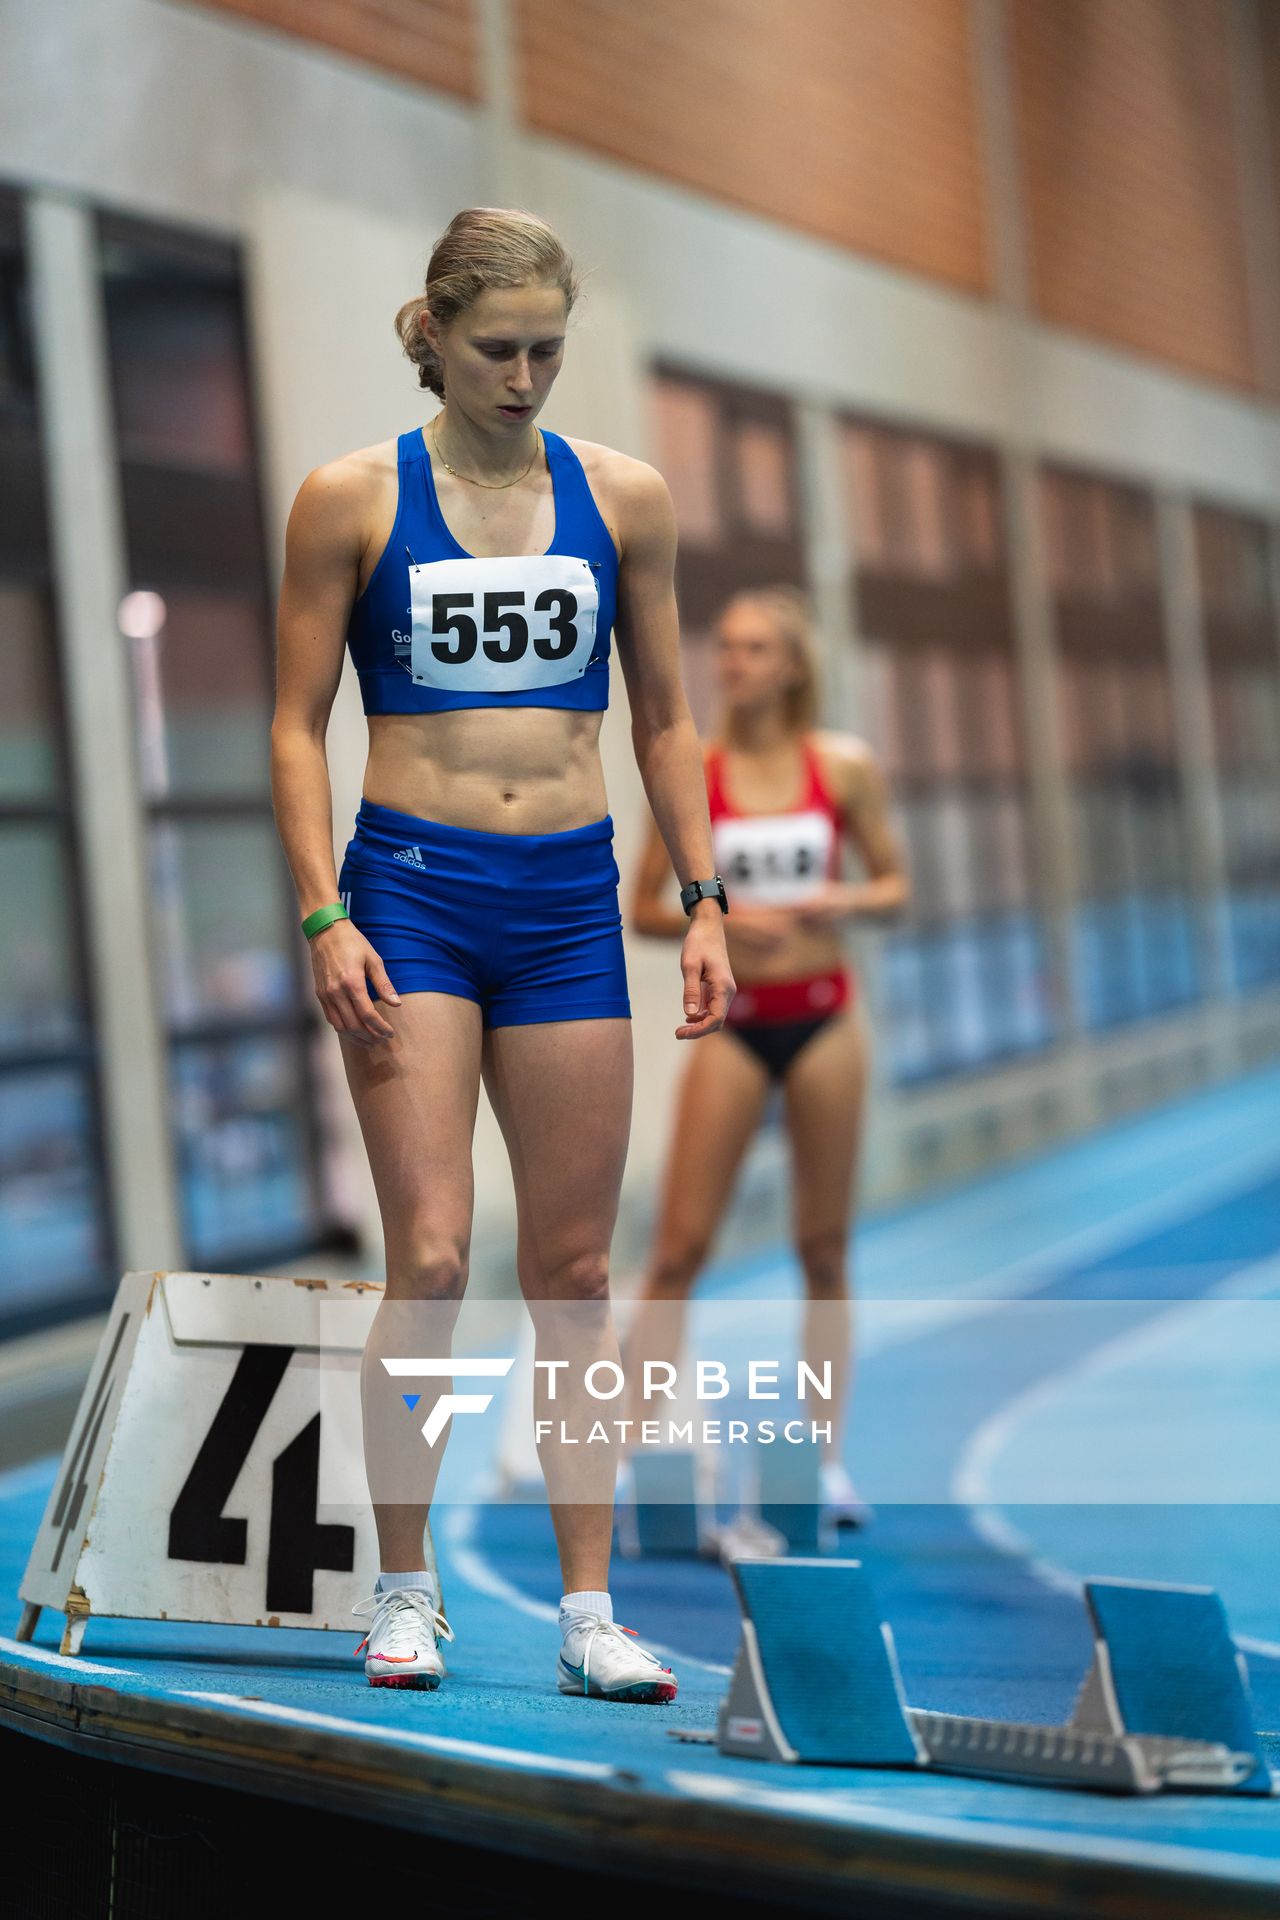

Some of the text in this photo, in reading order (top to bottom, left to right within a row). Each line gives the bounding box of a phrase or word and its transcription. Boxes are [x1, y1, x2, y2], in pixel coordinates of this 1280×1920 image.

[430, 588, 578, 664] 553
[393, 851, 427, 870] adidas
[168, 1345, 354, 1613] 4
